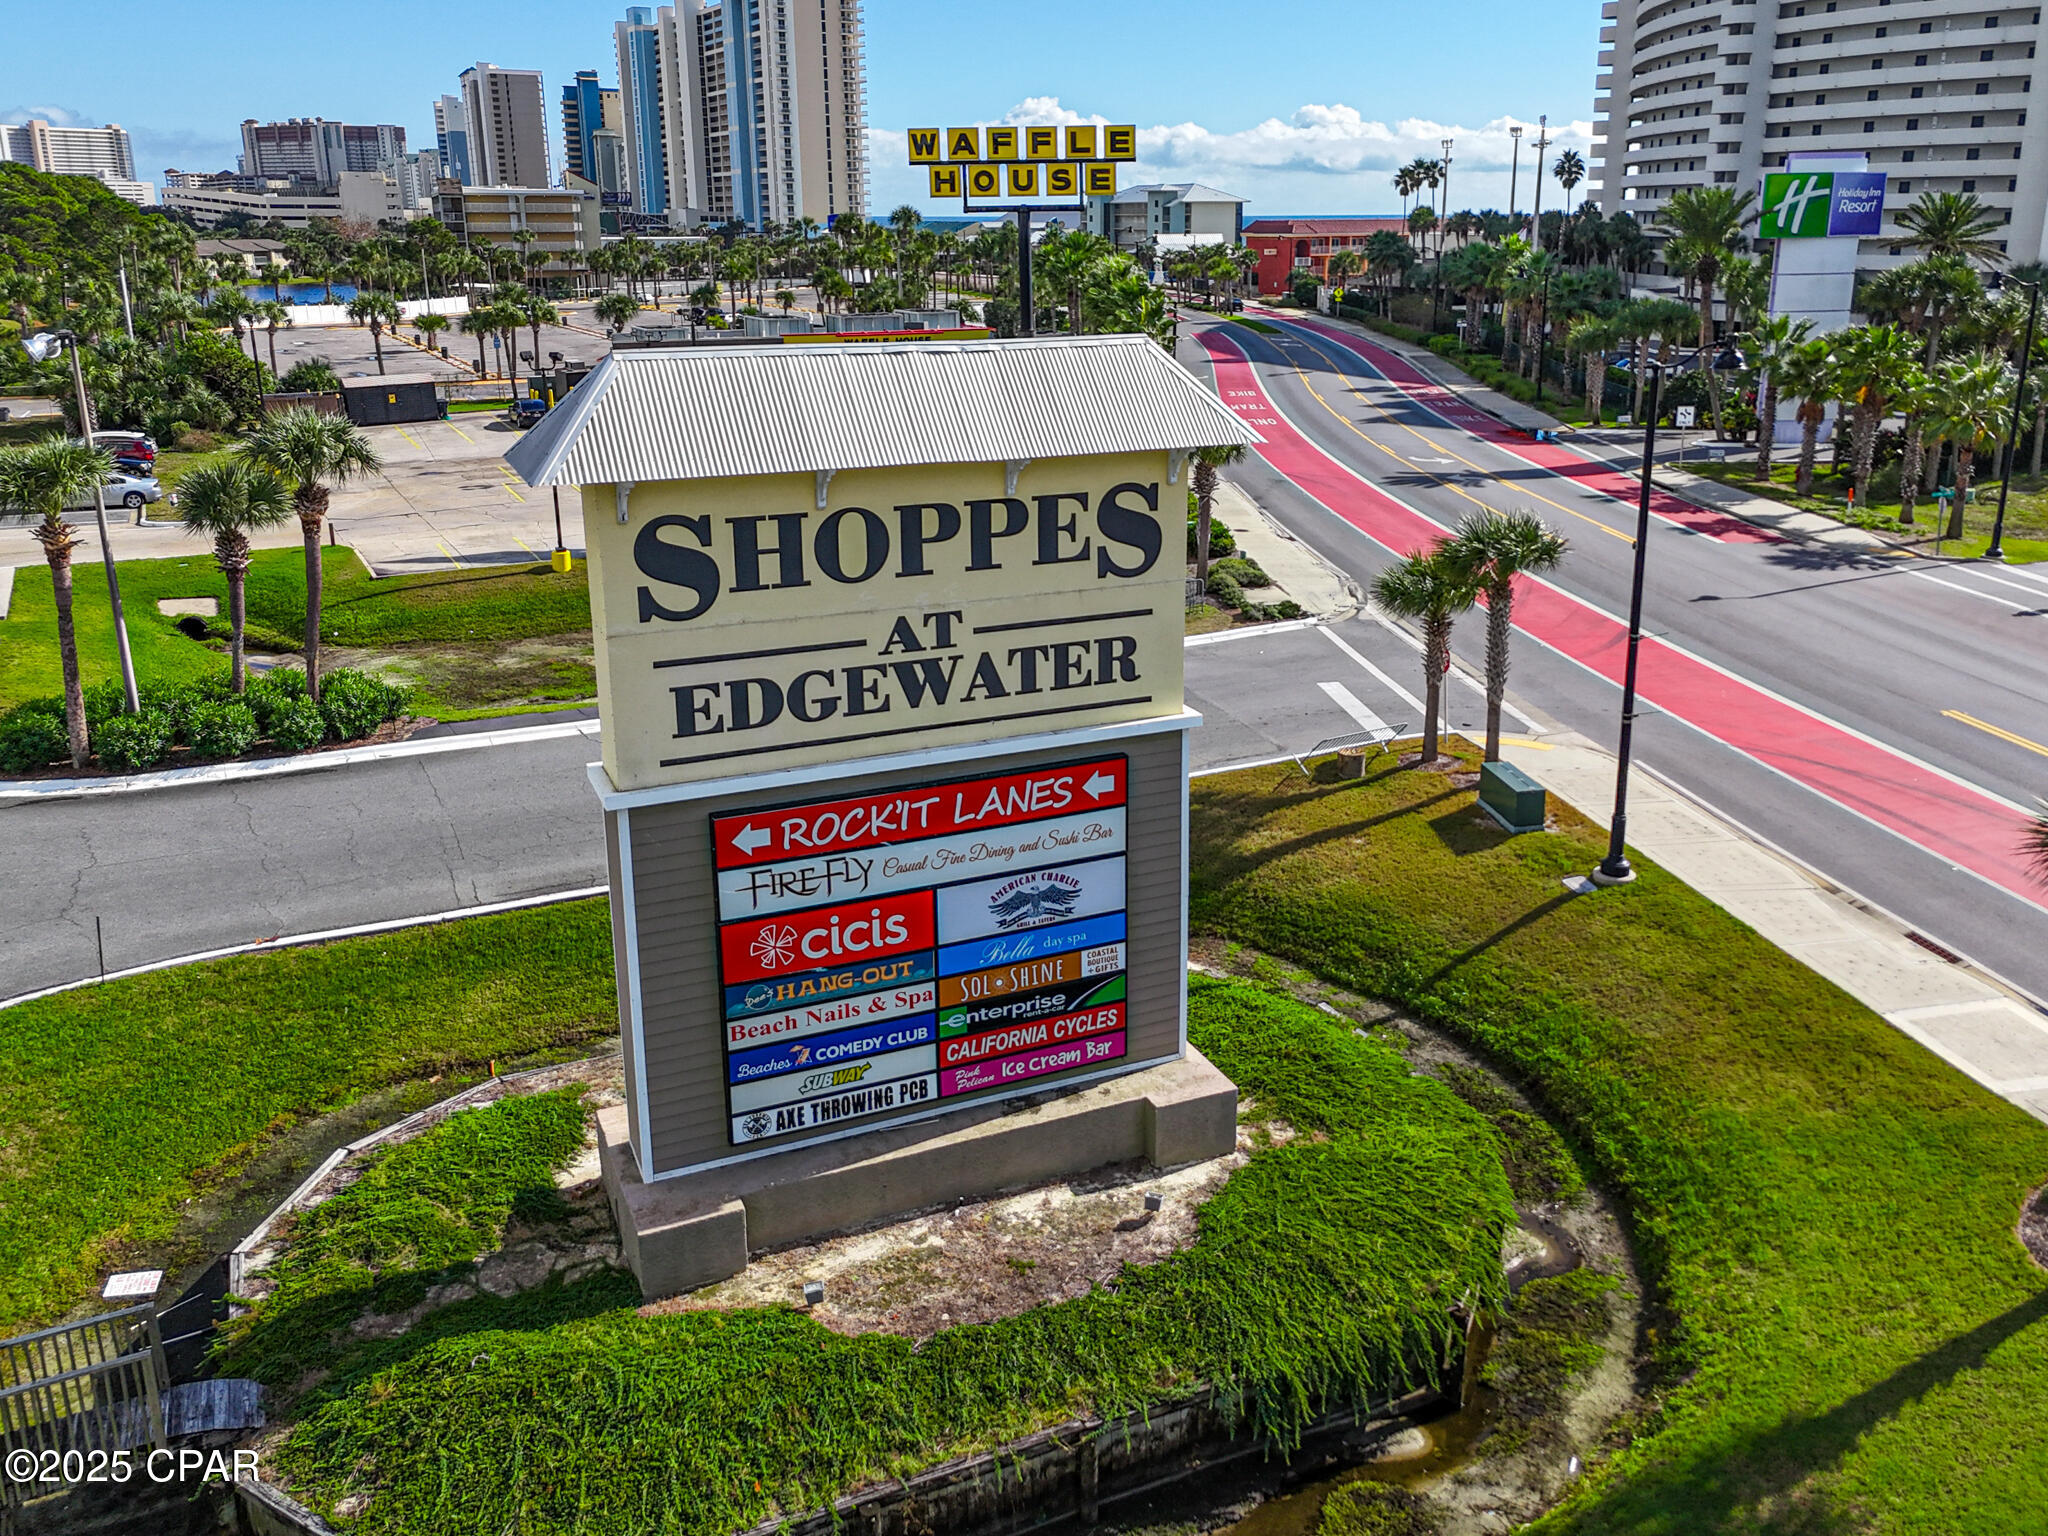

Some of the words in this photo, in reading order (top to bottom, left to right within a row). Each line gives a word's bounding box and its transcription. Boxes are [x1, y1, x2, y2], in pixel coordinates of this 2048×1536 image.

[911, 131, 1130, 156] WAFFLE
[934, 168, 1111, 192] HOUSE
[1838, 187, 1868, 199] Holiday
[1868, 187, 1881, 197] Inn
[1838, 199, 1877, 213] Resort
[633, 482, 1163, 623] SHOPPES
[879, 611, 963, 656] AT
[669, 636, 1142, 739] EDGEWATER
[781, 796, 941, 850] ROCK'IT
[954, 776, 1074, 824] LANES
[882, 855, 928, 878] Casual
[931, 849, 966, 870] Fine
[968, 842, 1016, 862] Dining
[1018, 841, 1040, 853] and
[1042, 829, 1080, 850] Sushi
[1083, 823, 1114, 842] Bar
[989, 872, 1037, 904] AMERICAN
[1041, 872, 1081, 889] CHARLIE
[801, 908, 908, 959] cicis
[979, 935, 1035, 965] Bella
[1043, 935, 1064, 949] day
[1067, 932, 1087, 947] spa
[1086, 946, 1119, 959] COASTAL
[1087, 955, 1119, 967] BOUTIQUE
[776, 960, 914, 1001] HANG-OUT
[960, 976, 991, 1002] SOL
[1010, 959, 1064, 992] SHINE
[730, 1015, 798, 1042] Beach
[805, 1003, 861, 1027] Nails
[868, 996, 888, 1014] &
[895, 990, 934, 1010] Spa
[940, 993, 1067, 1028] enterprise
[1022, 1004, 1066, 1018] rent-a-car
[737, 1056, 793, 1078] Beaches
[815, 1035, 883, 1061] COMEDY
[886, 1026, 929, 1046] CLUB
[946, 1024, 1048, 1062] CALIFORNIA
[1053, 1008, 1118, 1039] CYCLES
[1085, 1040, 1113, 1059] Bar
[799, 1061, 873, 1096] SUBWAY
[955, 1065, 981, 1081] Pink
[956, 1074, 995, 1092] Pelican
[776, 1104, 806, 1132] AXE
[810, 1085, 894, 1122] THROWING
[899, 1078, 929, 1104] PCB
